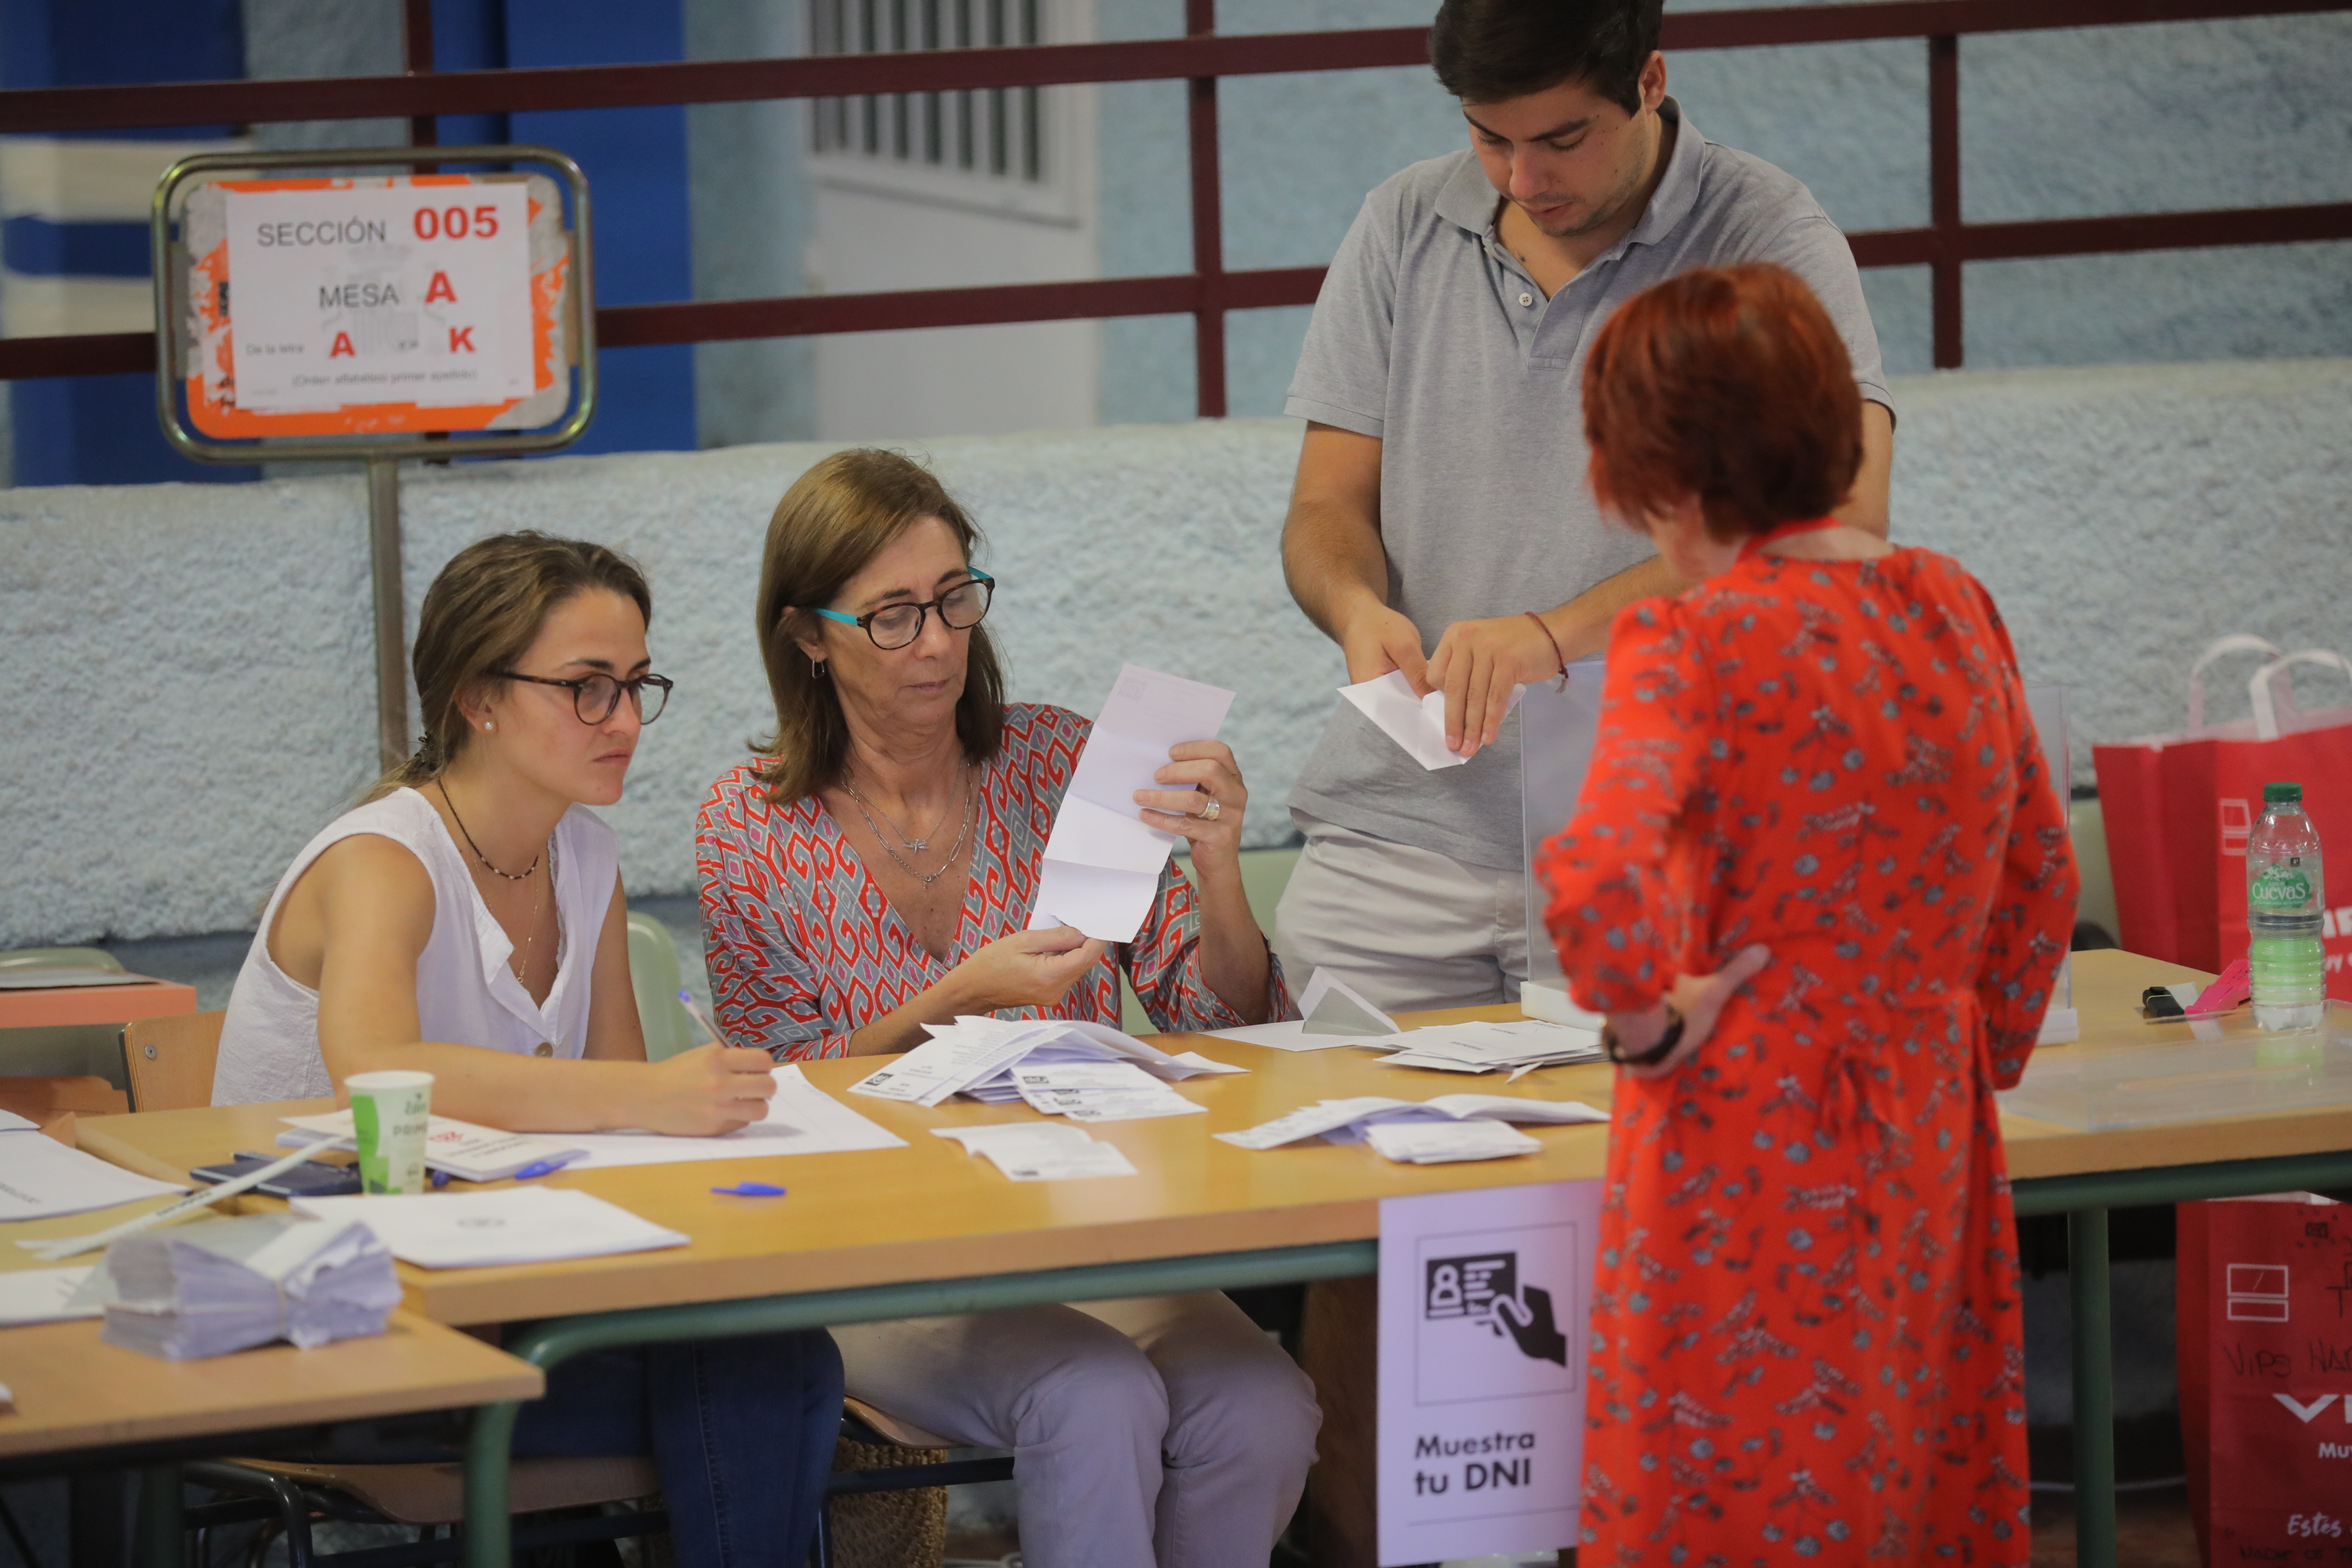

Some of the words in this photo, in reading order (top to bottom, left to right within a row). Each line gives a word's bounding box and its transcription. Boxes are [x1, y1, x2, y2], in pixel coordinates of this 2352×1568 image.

[256, 216, 386, 247] SECCIÓN
[413, 205, 499, 240] 005
[318, 283, 400, 308] MESA
[425, 271, 458, 304] A
[330, 331, 356, 358] A
[449, 325, 475, 354] K
[1415, 1430, 1536, 1459] Muestra
[2318, 1442, 2352, 1461] Mu
[1415, 1471, 1449, 1494] tu
[1465, 1458, 1530, 1490] DNI
